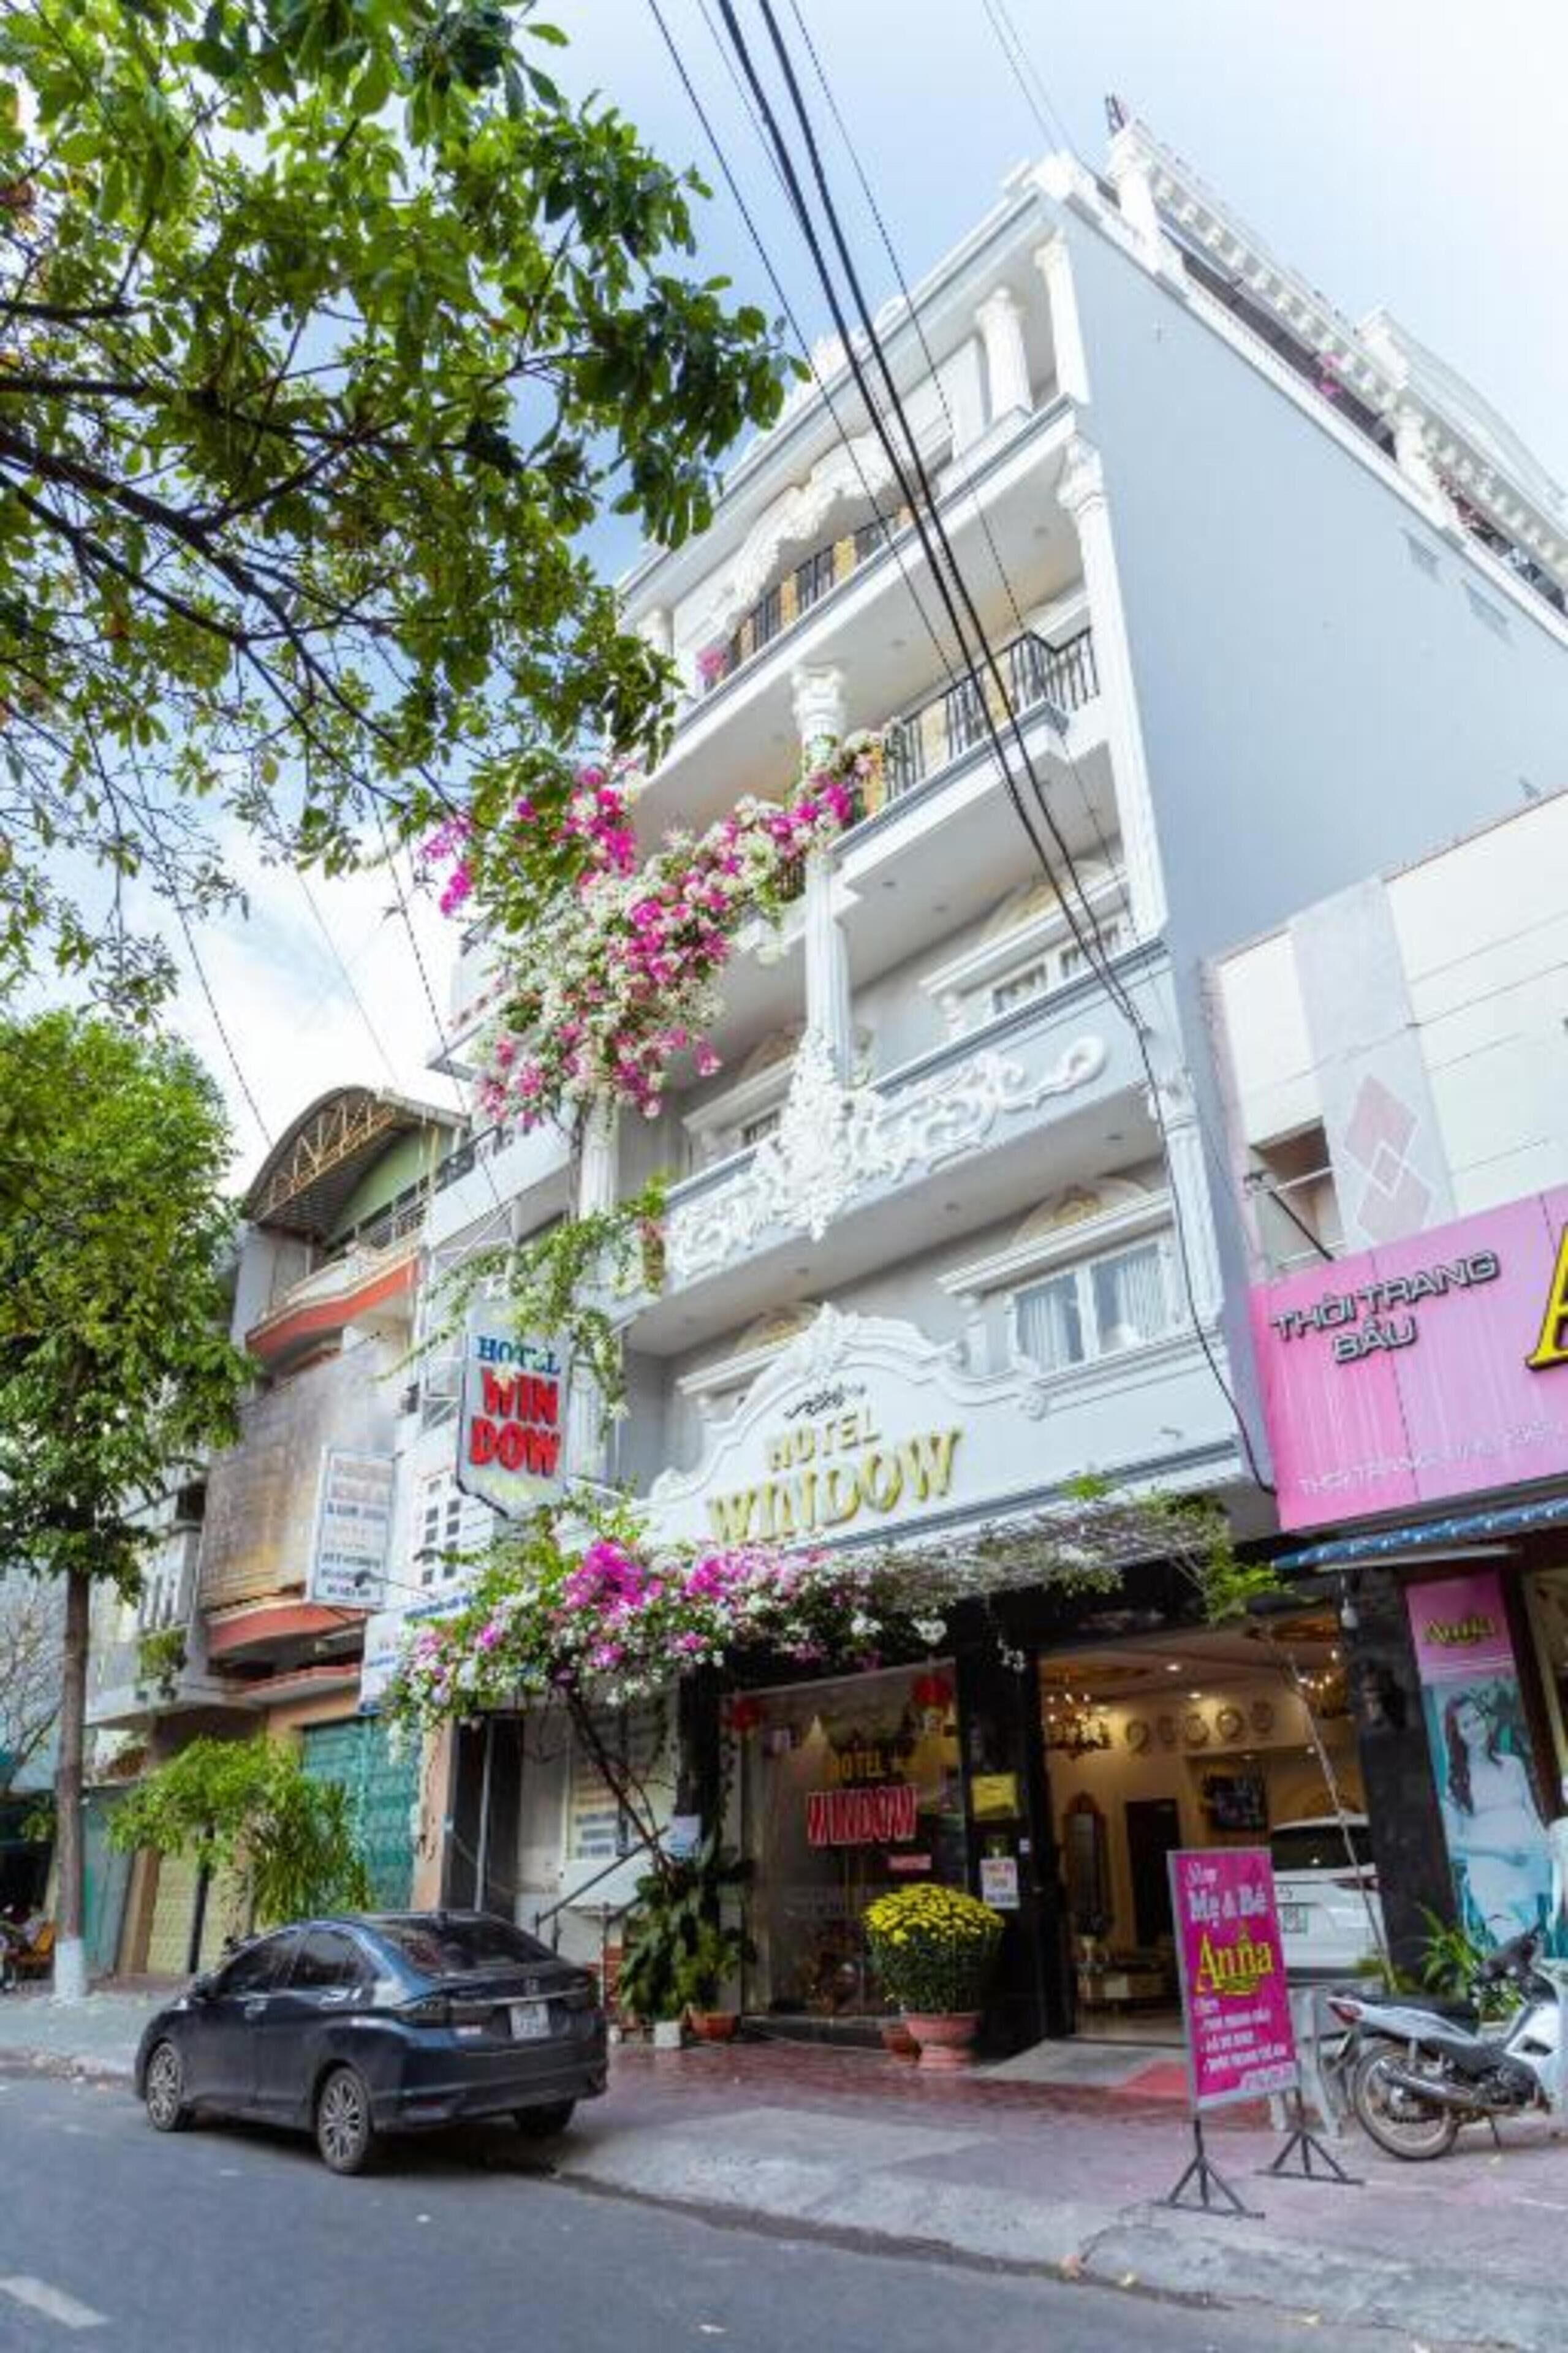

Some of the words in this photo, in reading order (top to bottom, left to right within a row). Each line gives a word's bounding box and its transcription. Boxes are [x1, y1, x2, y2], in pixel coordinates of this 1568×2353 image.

[1357, 1250, 1501, 1315] TRANG
[482, 1366, 558, 1426] WIN
[469, 1415, 561, 1477] DOW
[767, 1406, 881, 1472] HOTEL
[708, 1424, 961, 1543] WINDOW
